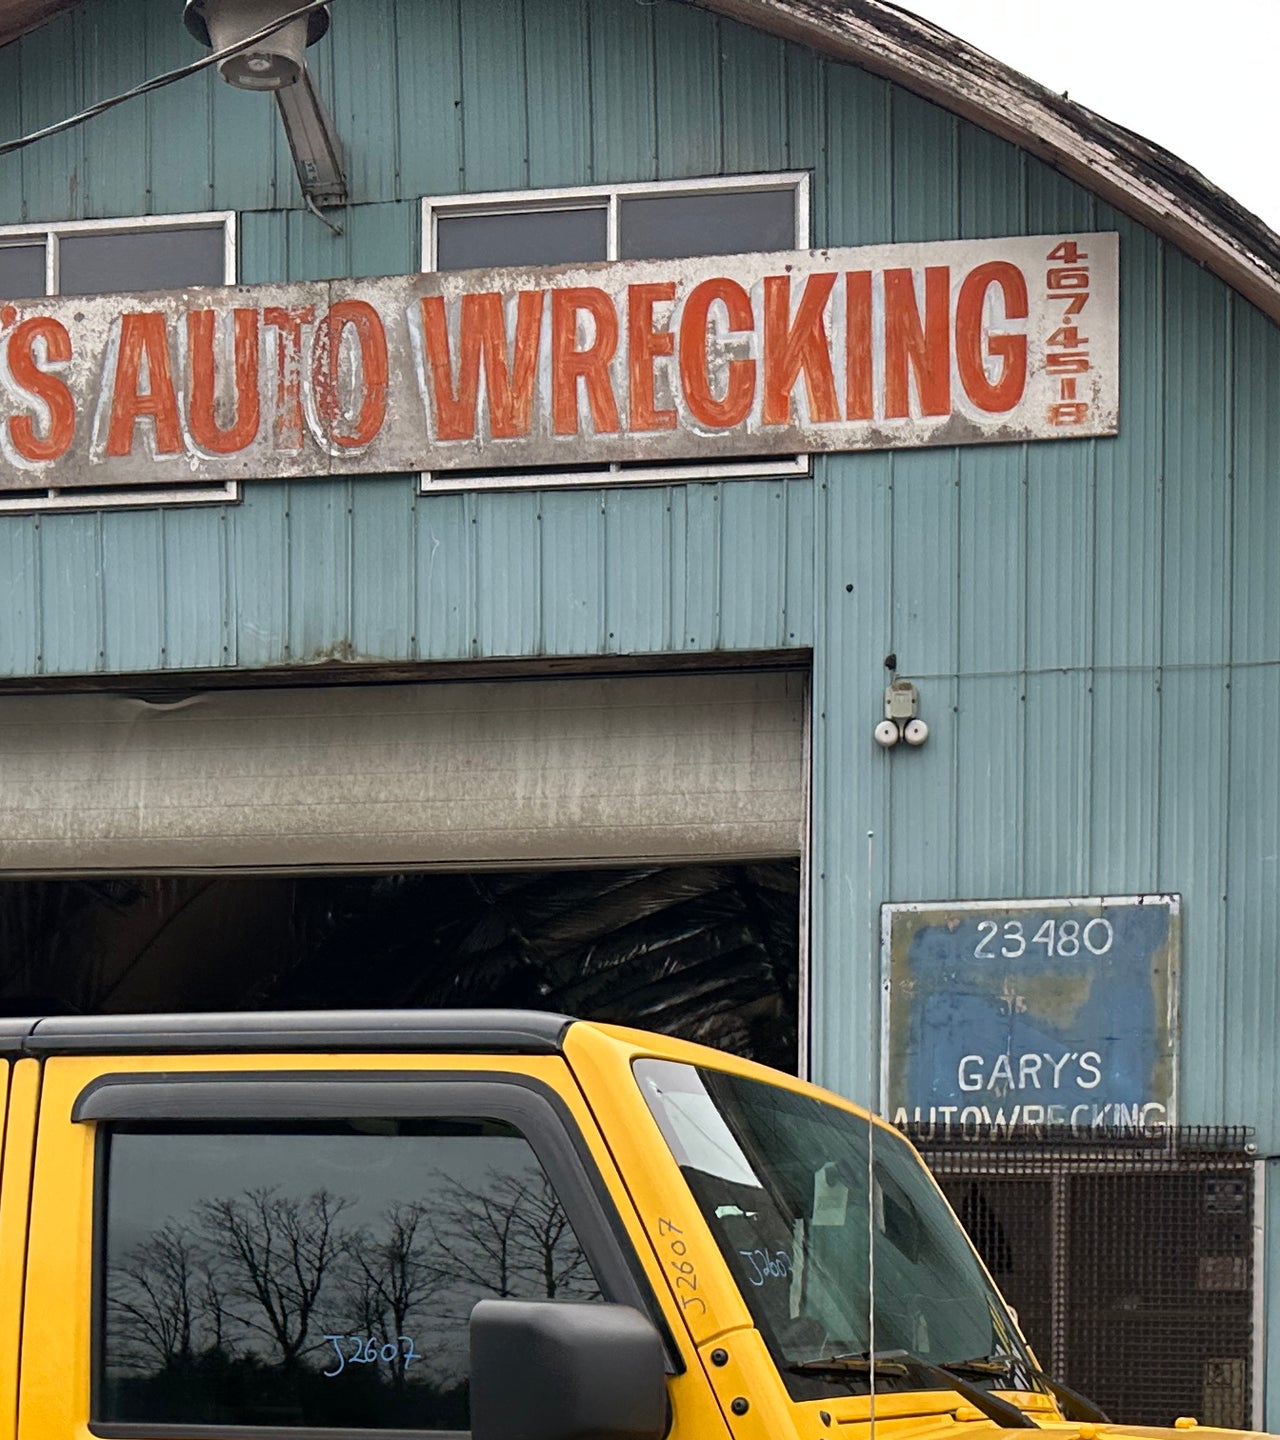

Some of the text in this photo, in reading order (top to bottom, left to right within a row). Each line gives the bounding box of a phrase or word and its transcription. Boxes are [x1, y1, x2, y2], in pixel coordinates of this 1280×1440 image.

[106, 299, 390, 456] AUTO
[420, 260, 1029, 443] WRECKING
[973, 917, 1114, 960] 23480
[958, 1050, 1102, 1092] GARY'S
[657, 1216, 707, 1315] J2607
[322, 1335, 422, 1377] J2607
